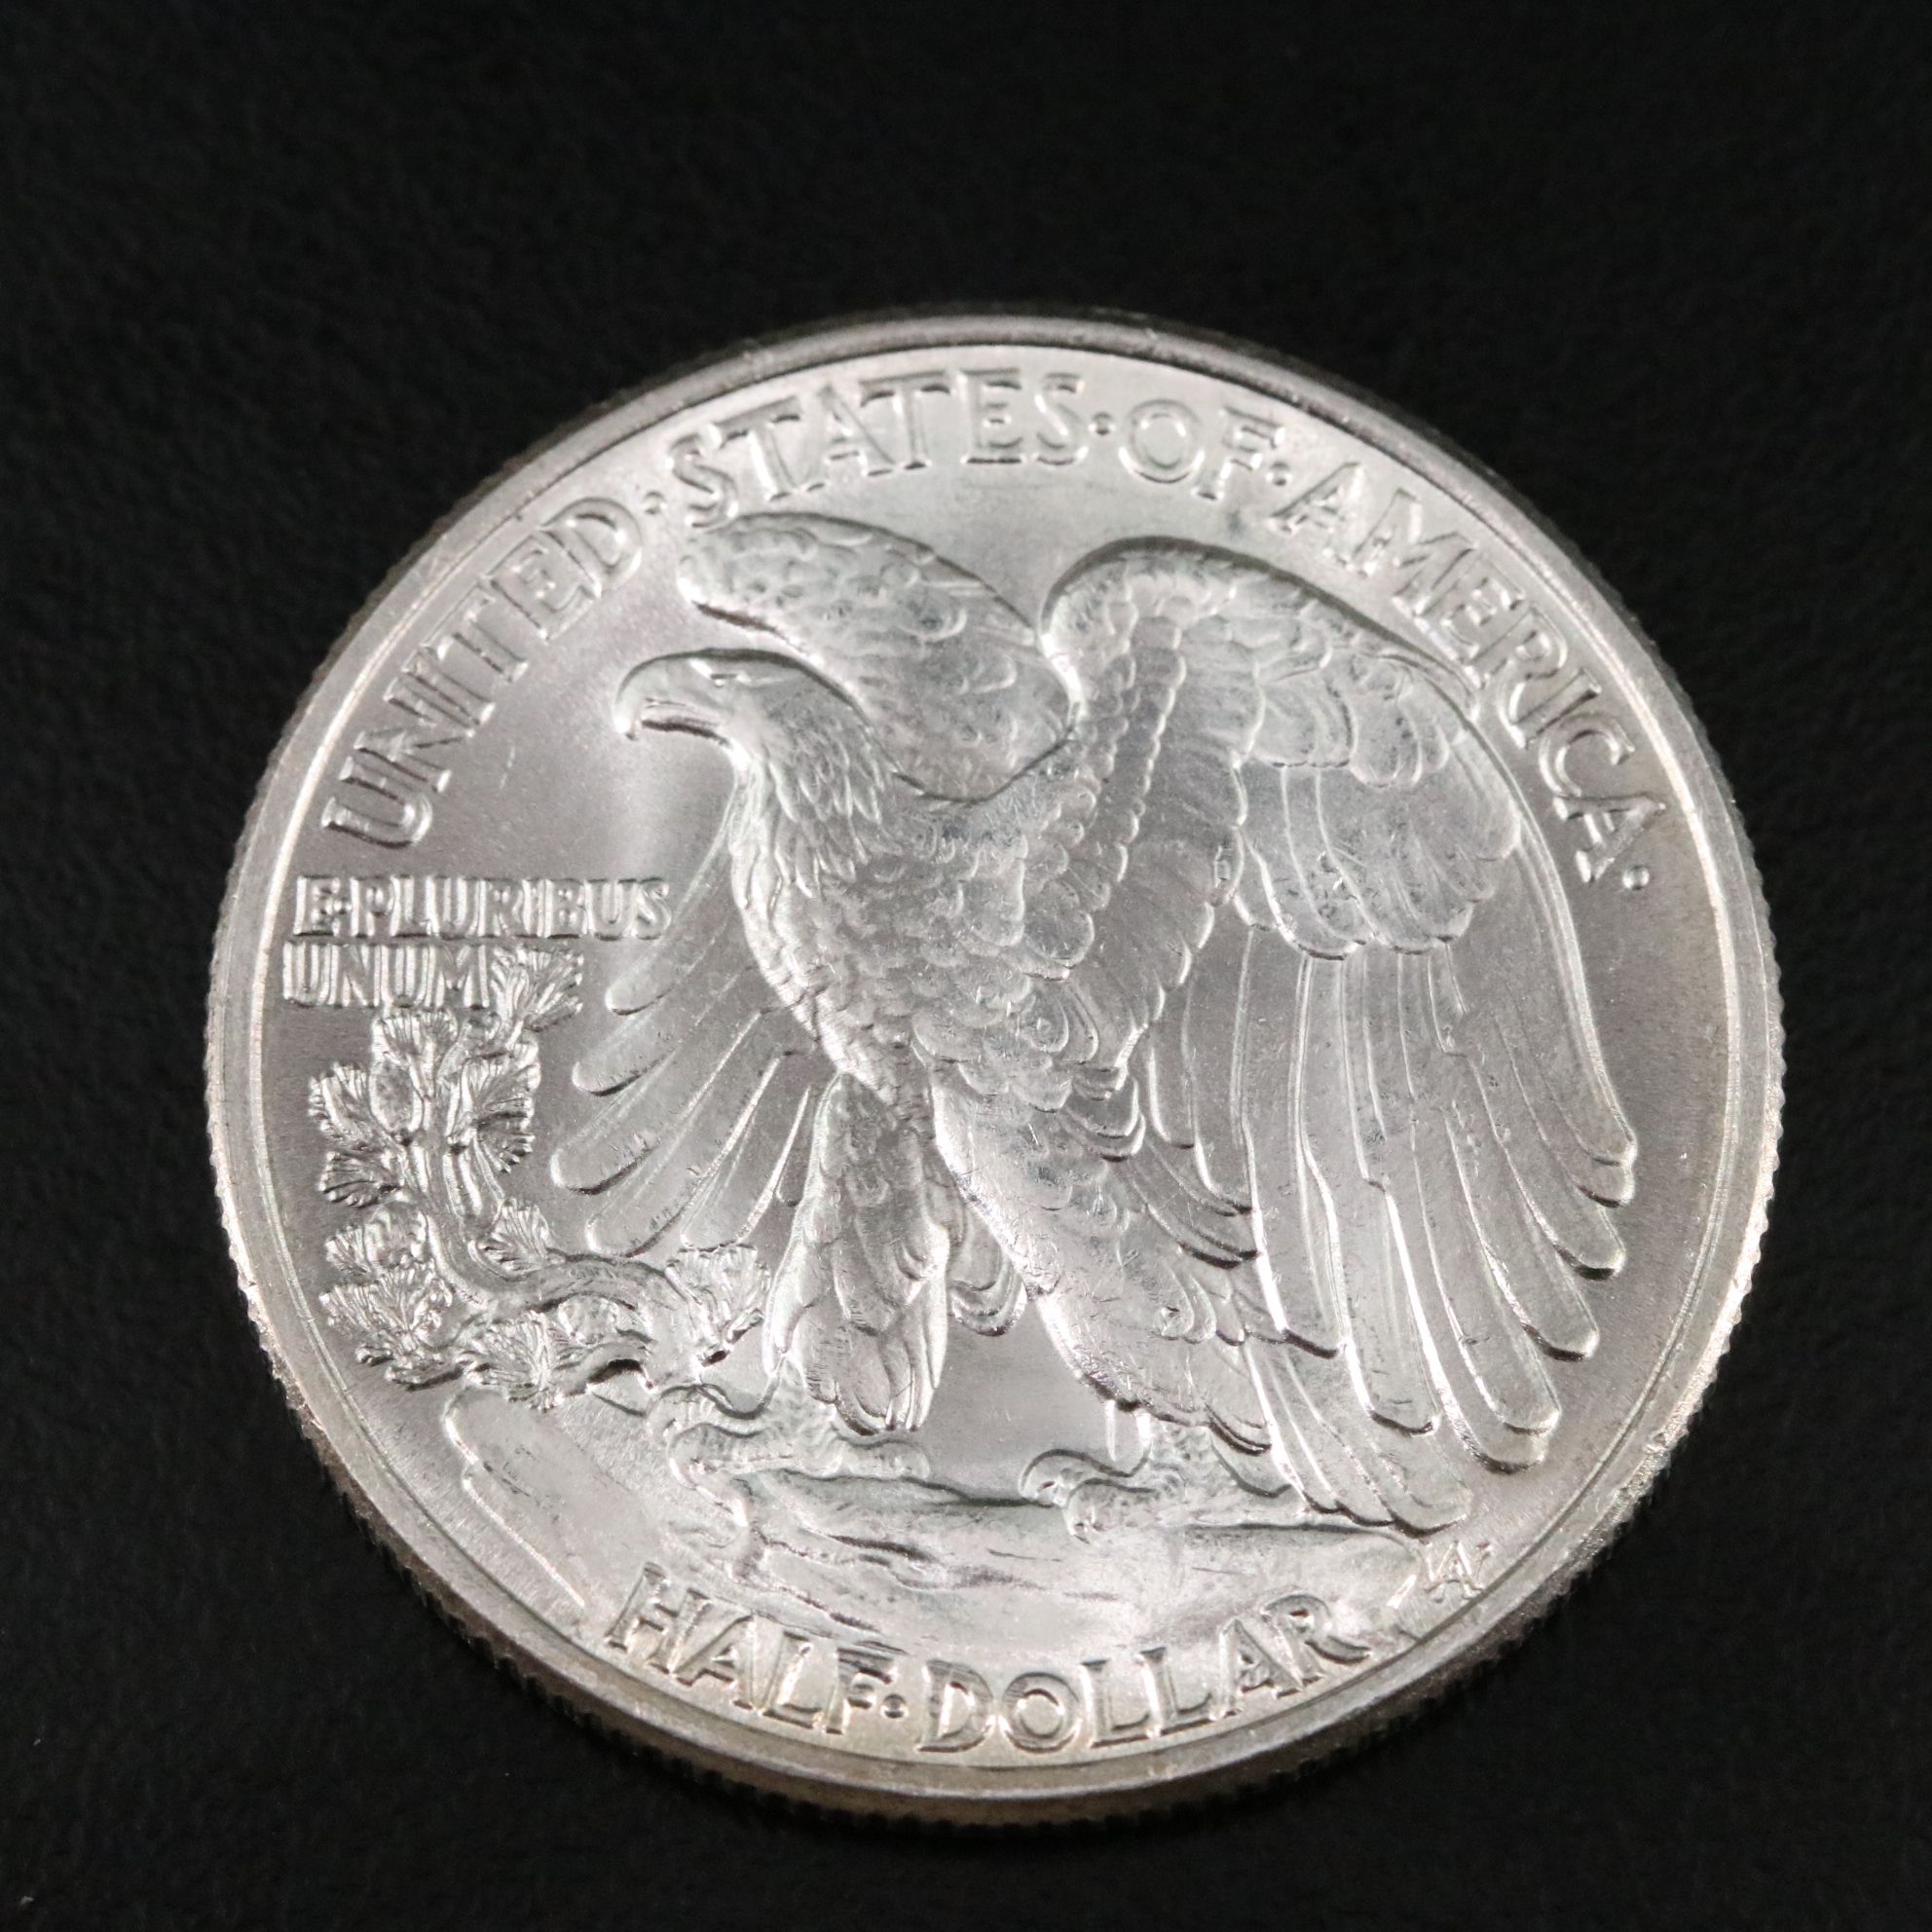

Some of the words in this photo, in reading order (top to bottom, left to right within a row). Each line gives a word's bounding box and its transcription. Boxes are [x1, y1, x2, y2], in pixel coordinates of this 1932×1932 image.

[321, 497, 644, 849] UNITED
[665, 366, 1090, 528] STATES
[1118, 398, 1286, 502] OF
[282, 940, 490, 1009] UNUM
[606, 1562, 898, 1735] HALF
[915, 1593, 1373, 1753] DOLLAR
